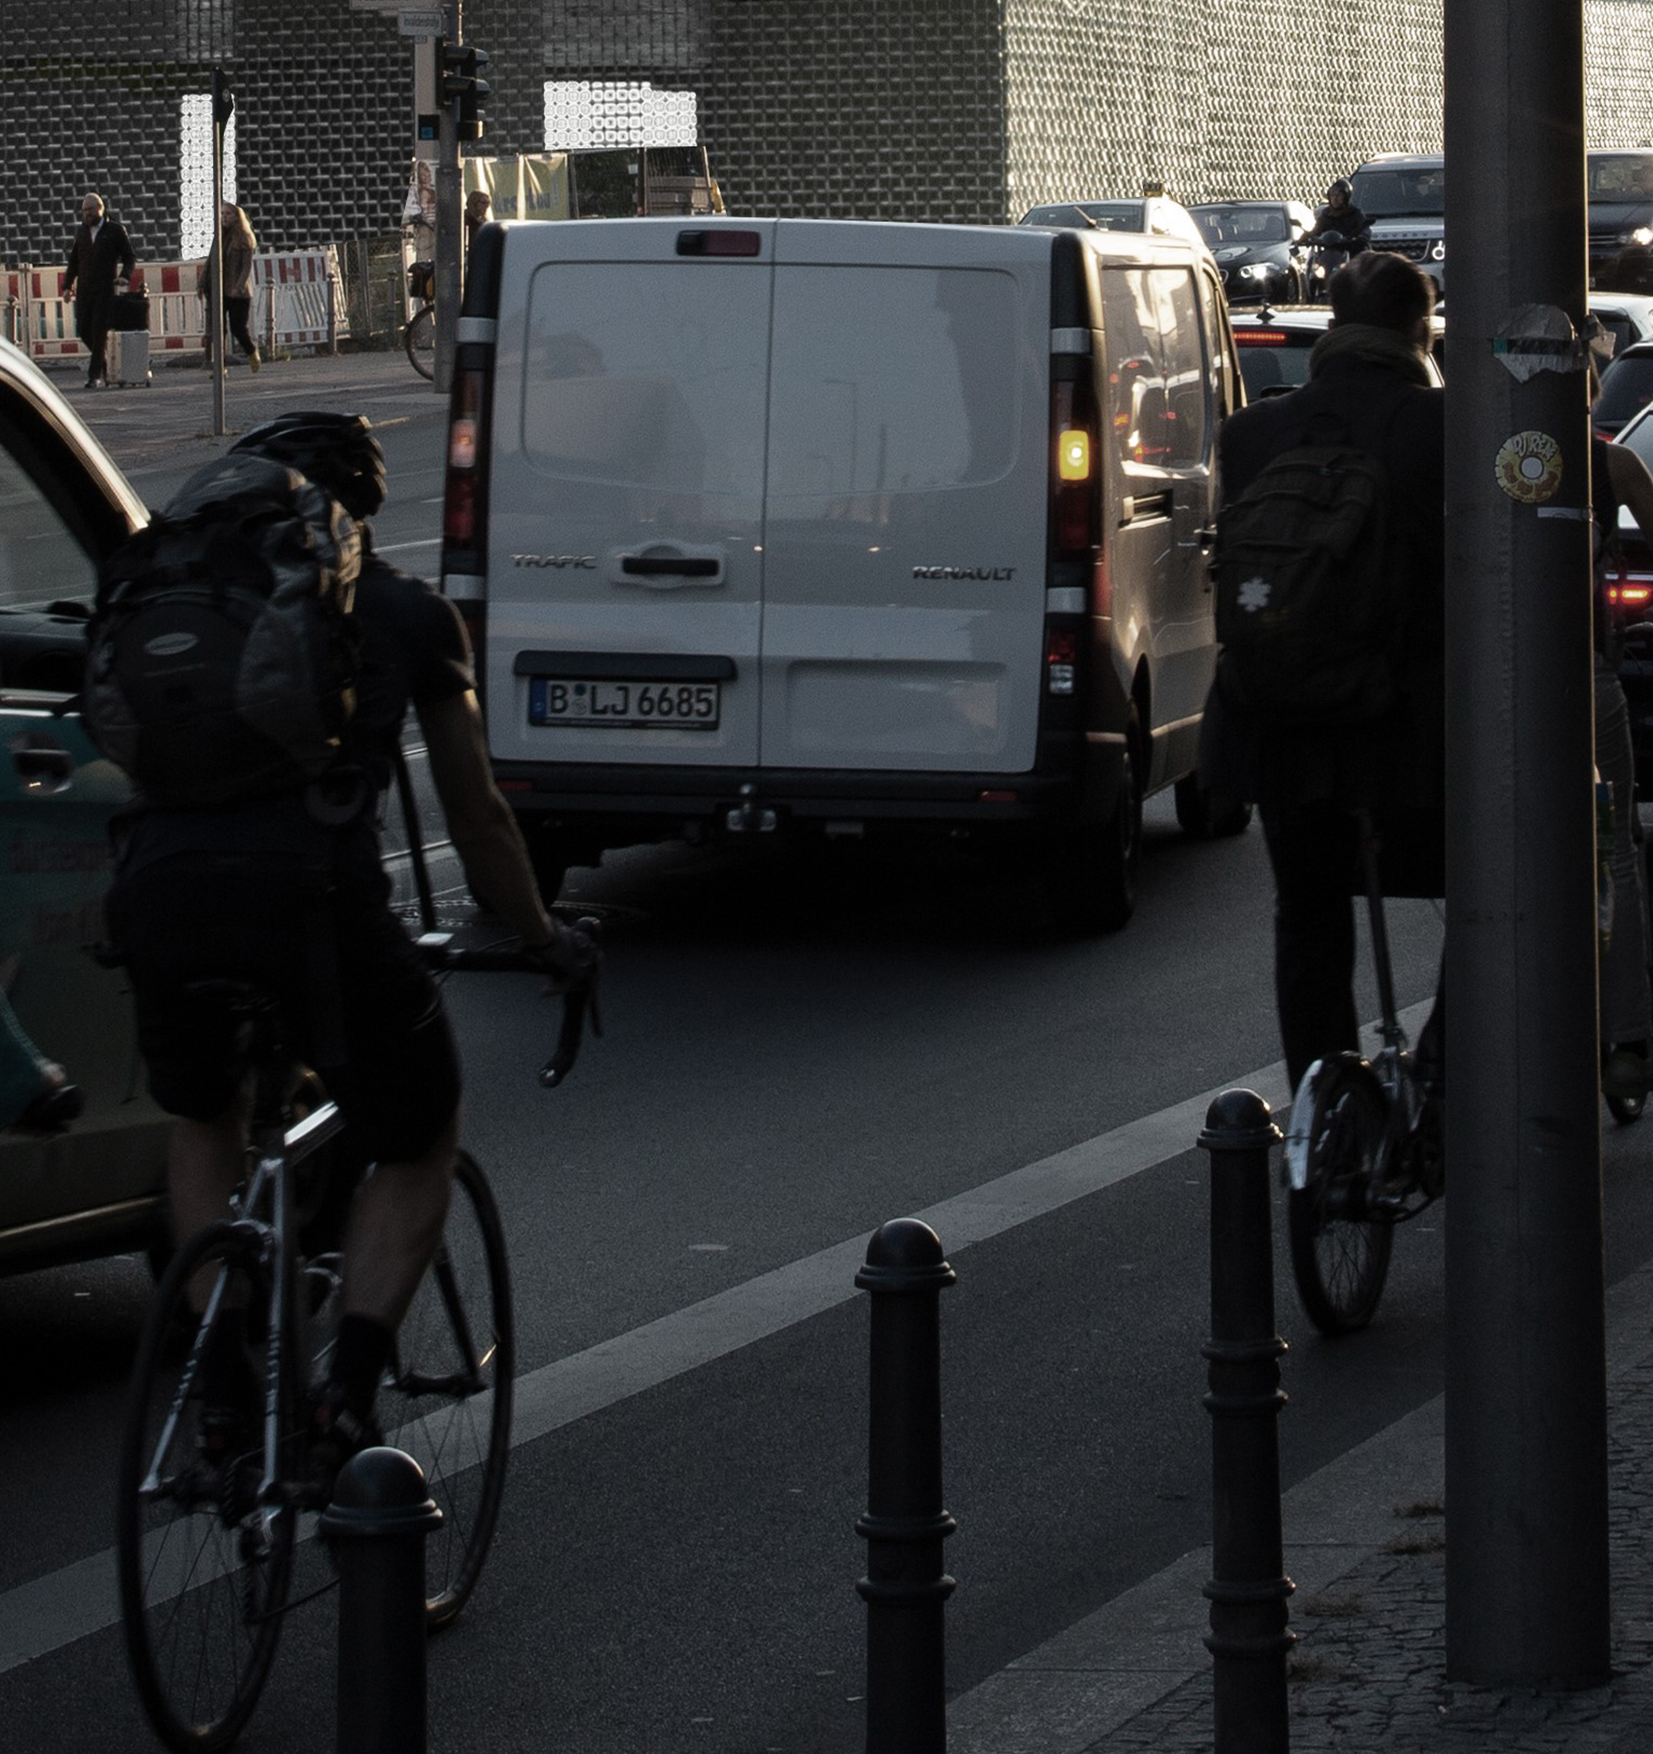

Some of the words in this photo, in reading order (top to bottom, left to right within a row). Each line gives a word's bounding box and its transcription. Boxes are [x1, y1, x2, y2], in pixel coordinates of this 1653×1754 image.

[511, 553, 596, 570] TRAFIC
[912, 565, 1017, 582] RENAULT
[550, 684, 568, 714] B
[591, 685, 630, 716] LJ
[637, 686, 713, 718] 6685
